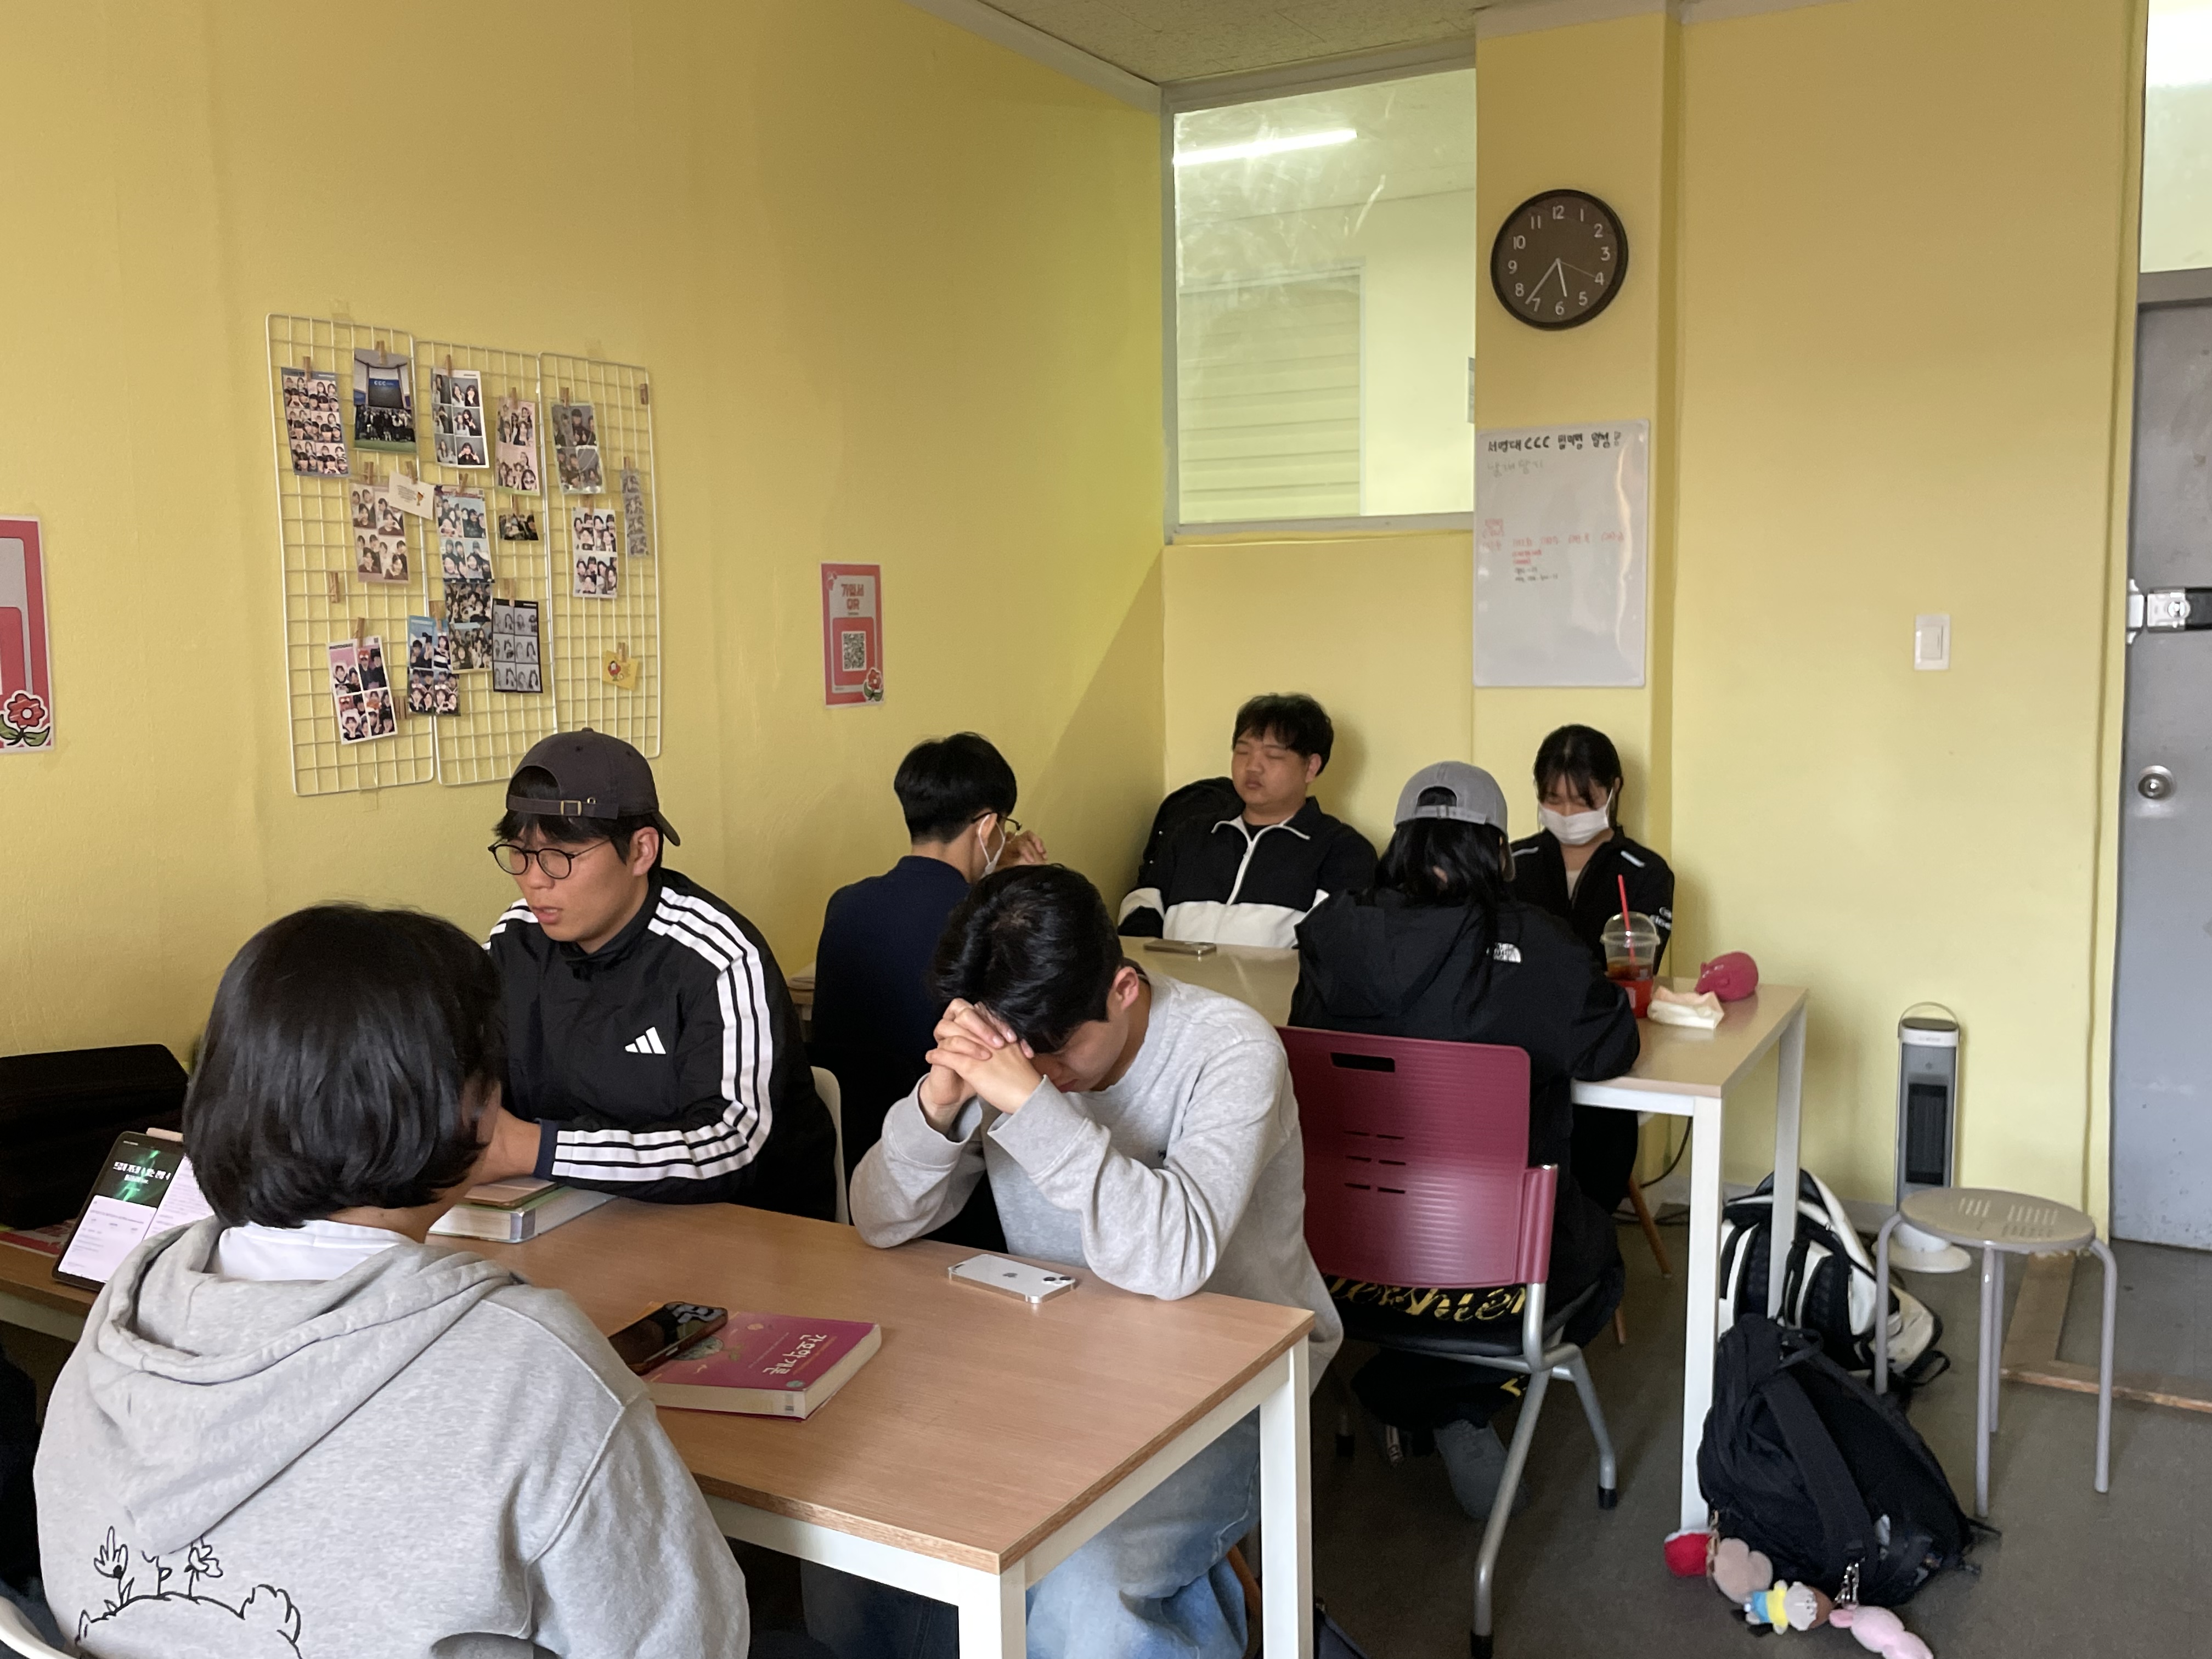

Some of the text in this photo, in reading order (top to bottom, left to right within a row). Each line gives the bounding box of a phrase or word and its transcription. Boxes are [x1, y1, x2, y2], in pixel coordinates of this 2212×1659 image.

[1552, 205, 1564, 219] 12
[1579, 208, 1584, 222] 1
[1531, 215, 1541, 230] 11
[1594, 223, 1603, 238] 2
[1513, 235, 1526, 250] 10
[1601, 246, 1611, 261] 3
[1508, 260, 1517, 274] 9
[1594, 272, 1604, 286] 4
[1515, 283, 1525, 297] 8
[1532, 297, 1541, 312] 7
[1579, 291, 1588, 306] 5
[1555, 301, 1565, 315] 6
[847, 598, 860, 610] QR
[782, 1334, 827, 1359] 간호학
[762, 1358, 798, 1375] 개론
